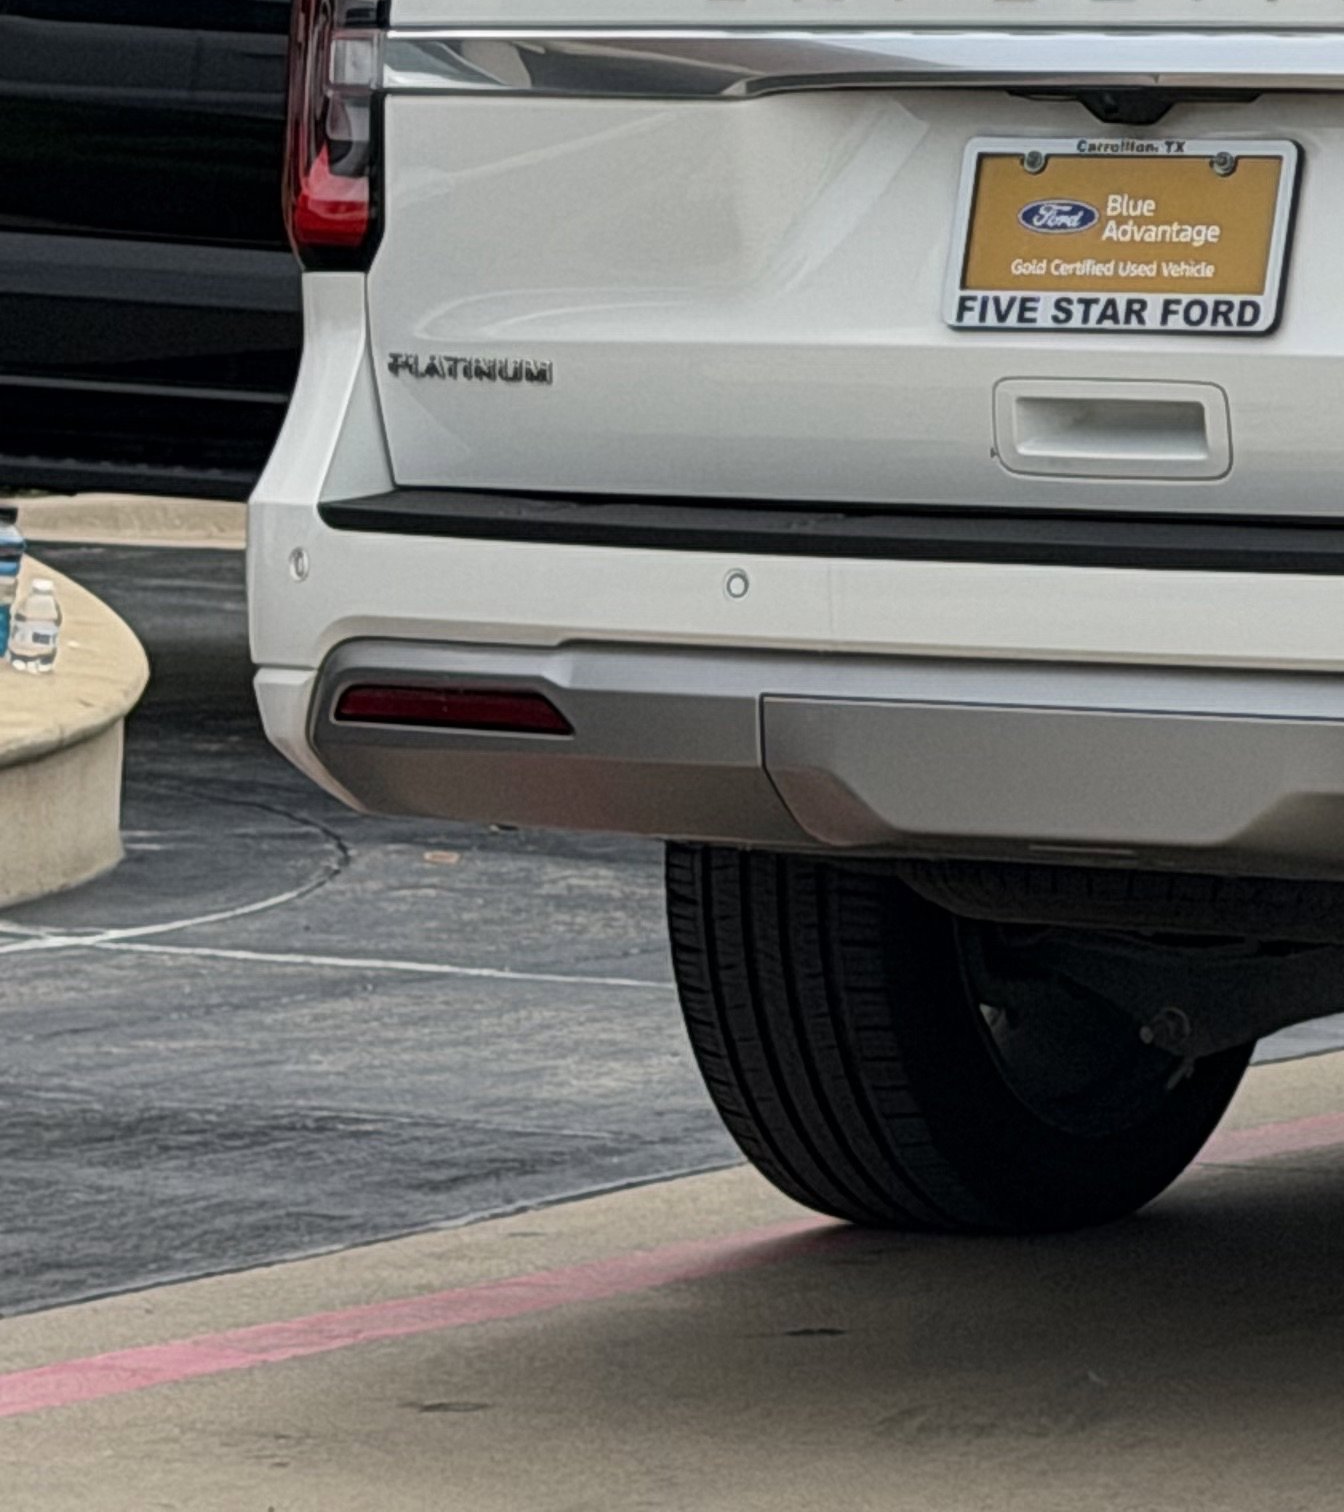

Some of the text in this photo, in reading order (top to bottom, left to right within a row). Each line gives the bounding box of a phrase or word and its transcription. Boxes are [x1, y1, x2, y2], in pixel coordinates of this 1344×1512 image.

[1164, 140, 1186, 154] TX
[1031, 202, 1085, 228] Ford
[1105, 193, 1157, 218] Blue
[1101, 219, 1221, 247] Advantage
[1010, 258, 1216, 279] Gold Certified Used Vehicle
[955, 294, 1262, 328] FIVE STAR FORD
[387, 352, 554, 386] PLATINUM
